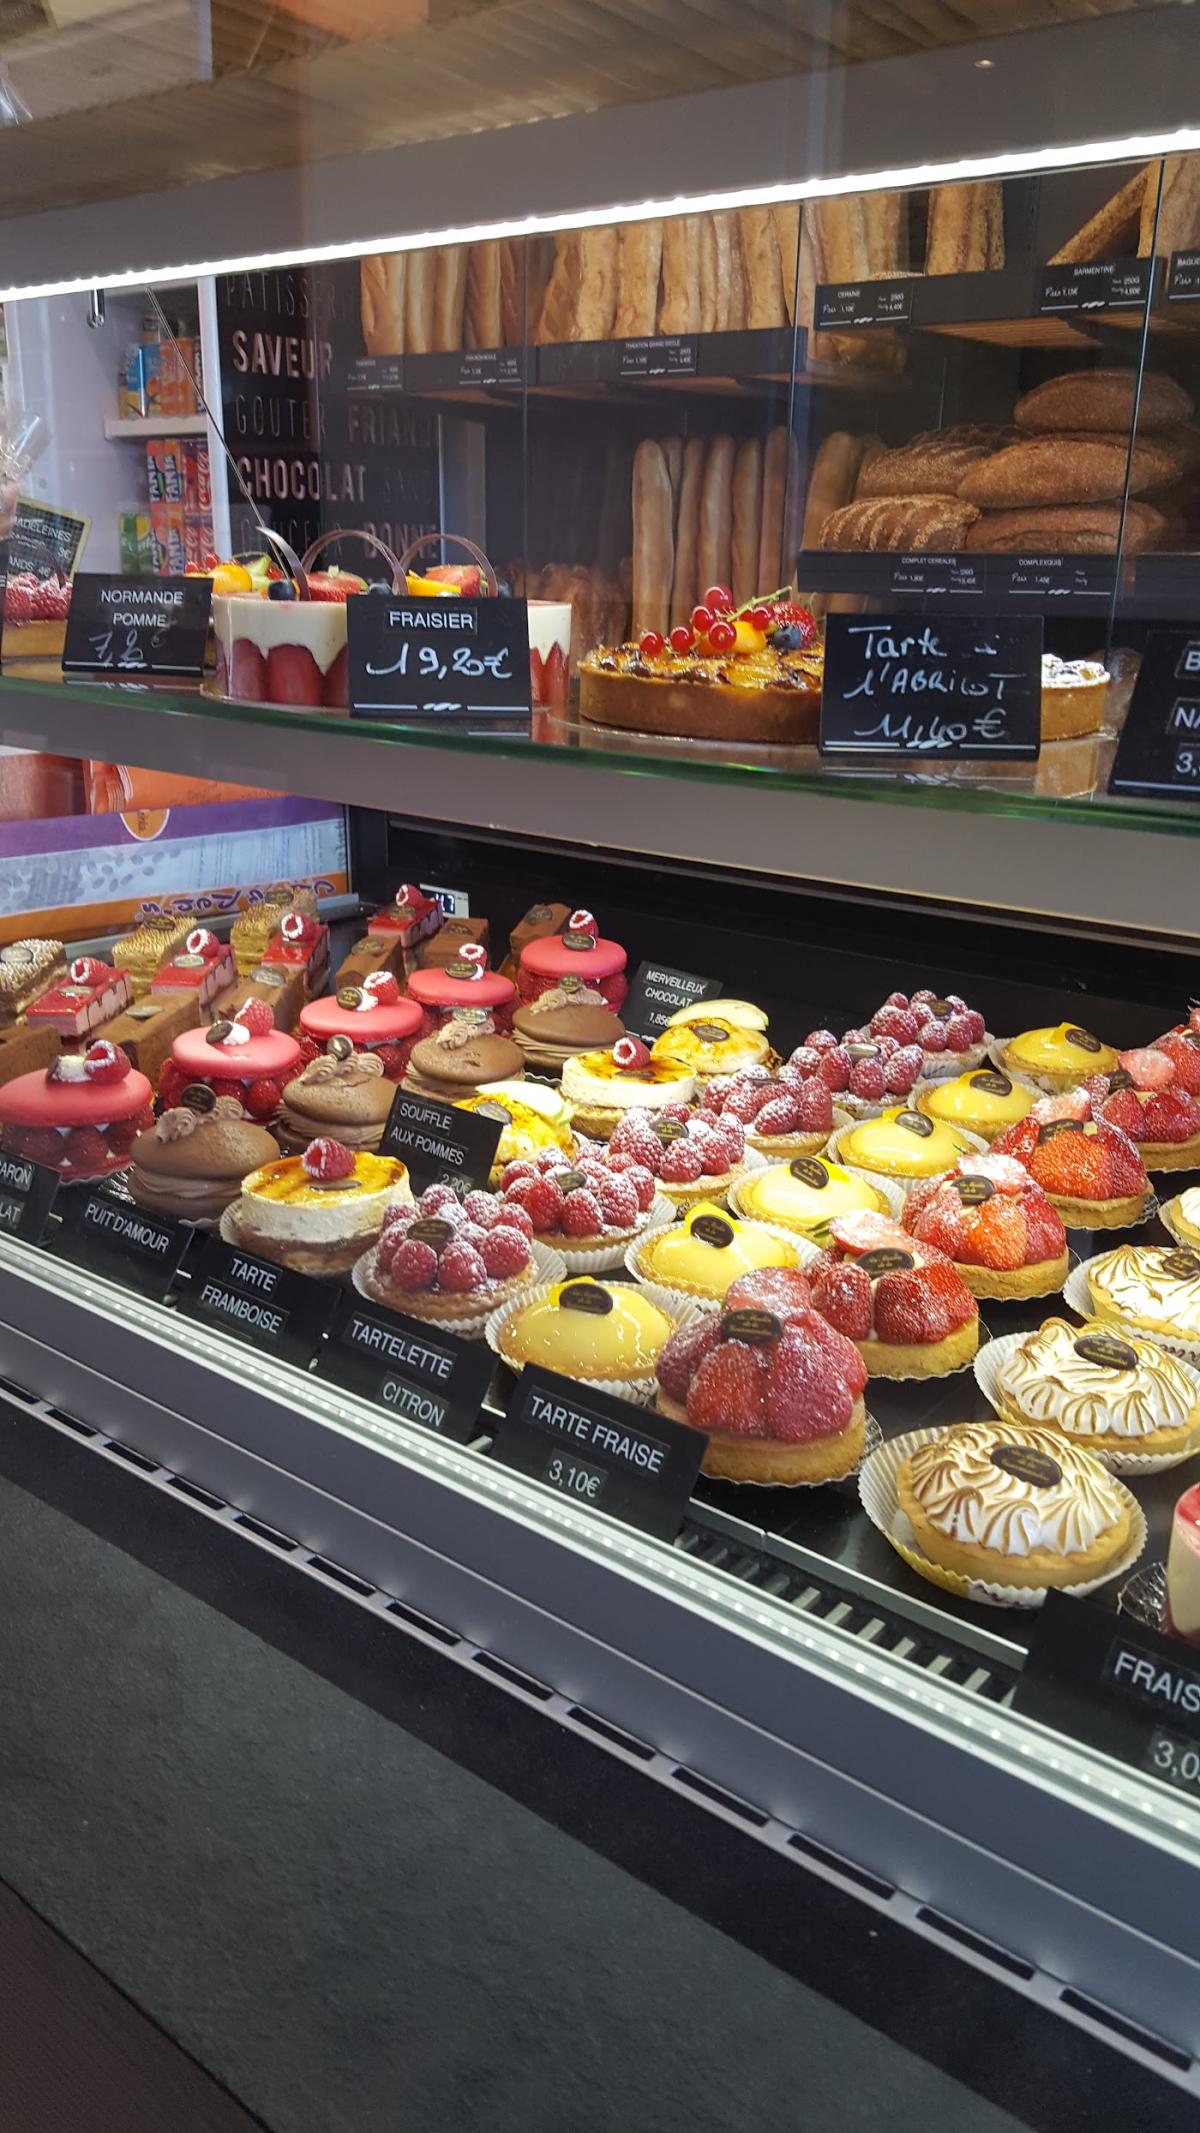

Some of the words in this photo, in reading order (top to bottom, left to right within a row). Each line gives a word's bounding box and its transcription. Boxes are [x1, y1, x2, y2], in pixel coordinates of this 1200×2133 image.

[232, 329, 333, 381] SAVEUR
[235, 394, 327, 440] GOUTER
[236, 456, 367, 502] CHOCOLAT
[101, 590, 184, 605] NORMANDE
[113, 612, 168, 627] POMME
[389, 610, 474, 629] FRAISIER
[645, 987, 693, 1007] CHOCOLAT
[646, 970, 706, 995] MERVEILLEUX
[400, 1102, 452, 1131] SOUFFLE
[390, 1125, 415, 1147] AUX
[414, 1135, 465, 1166] POMMES
[0, 1160, 33, 1185] ARON
[84, 1203, 114, 1227] PUIT
[113, 1216, 170, 1253] D'AMOUR
[231, 1258, 277, 1292] TARTE
[201, 1284, 283, 1334] FRAMBOISE
[351, 1319, 453, 1379] TARTELETTE
[382, 1381, 445, 1427] CITRON
[531, 1395, 591, 1440] TARTE
[591, 1423, 664, 1473] FRAISE
[548, 1459, 601, 1498] 3,10€
[1154, 1740, 1200, 1784] 3,0
